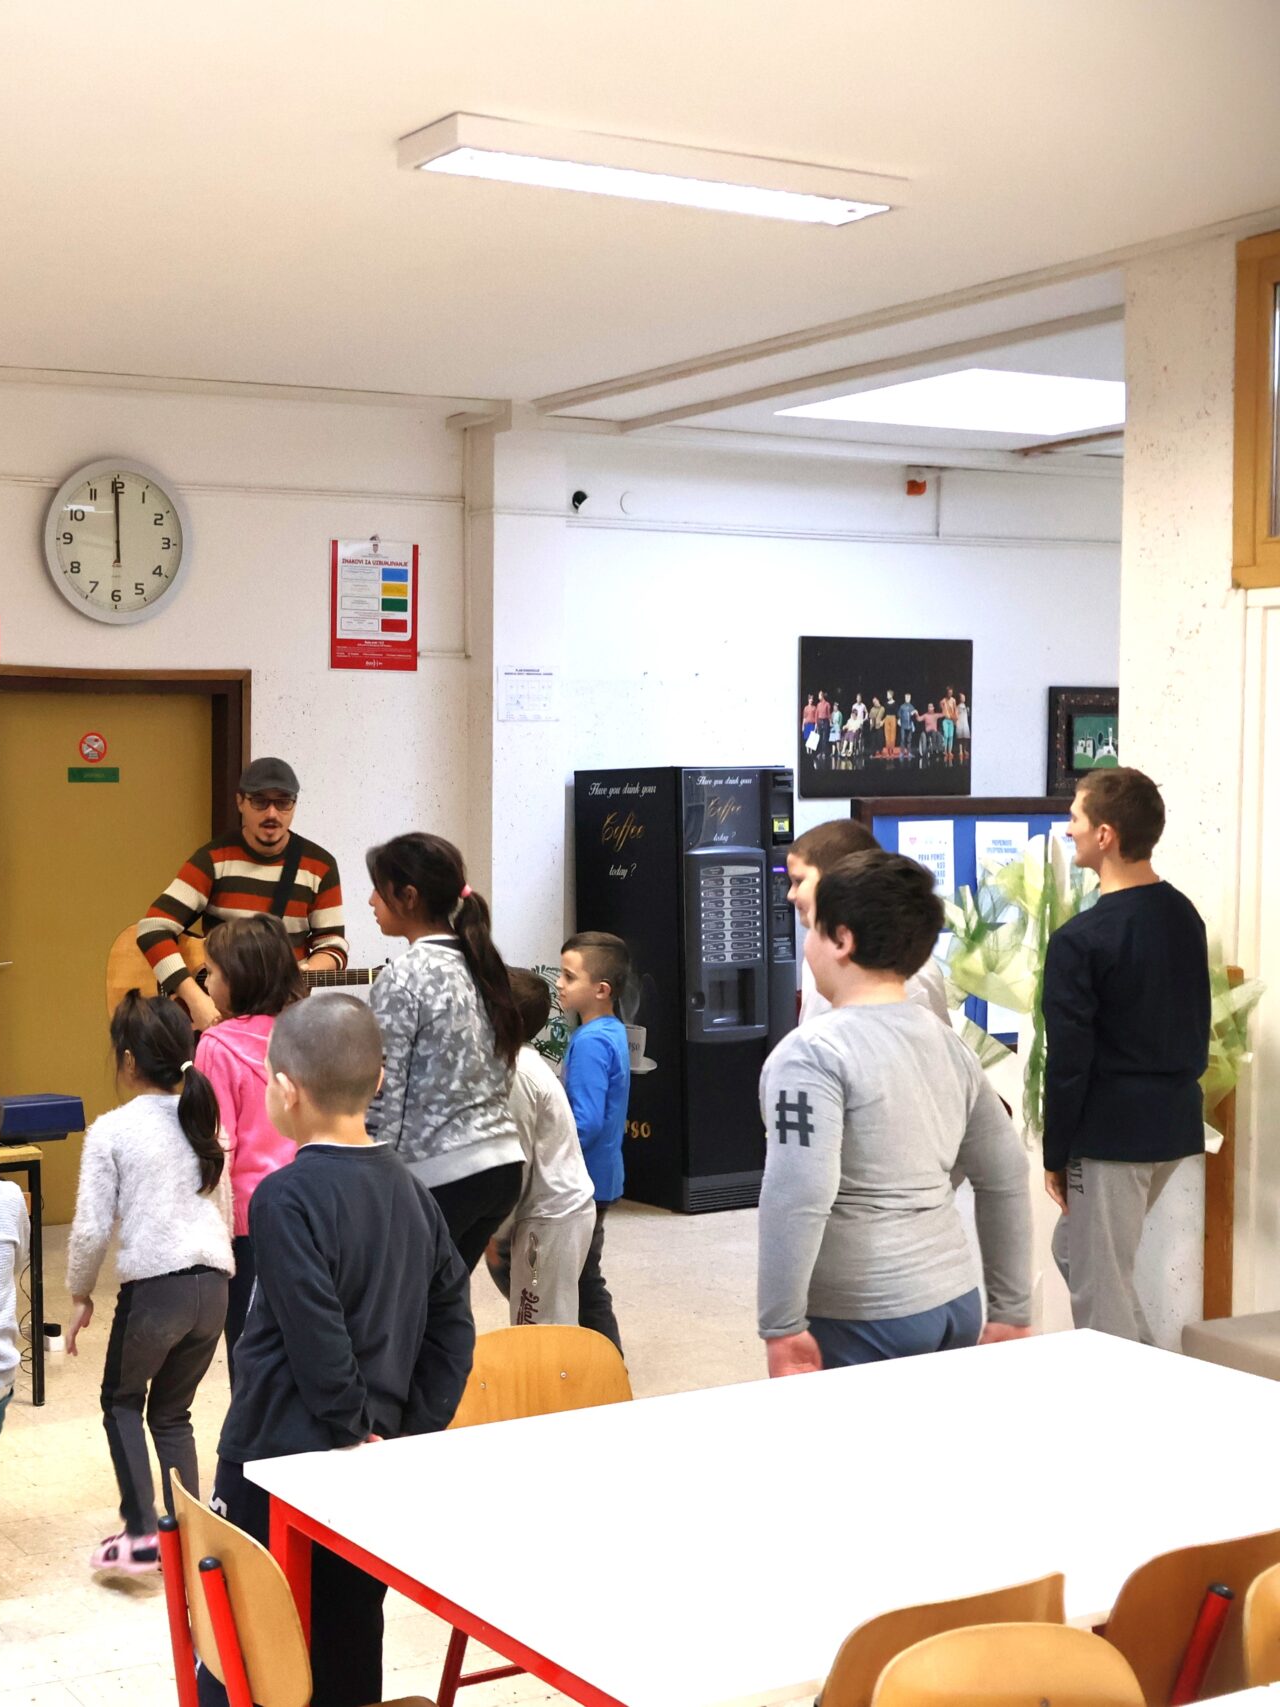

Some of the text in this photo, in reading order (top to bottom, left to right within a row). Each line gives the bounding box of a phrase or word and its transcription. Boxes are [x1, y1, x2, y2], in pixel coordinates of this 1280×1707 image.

[111, 481, 125, 494] 12
[89, 488, 97, 501] 11
[70, 509, 85, 521] 10
[154, 513, 164, 526] 2
[62, 532, 73, 545] 9
[161, 537, 171, 550] 3
[70, 561, 81, 574] 8
[152, 565, 163, 577] 4
[89, 581, 99, 593] 7
[134, 583, 145, 595] 5
[111, 589, 121, 602] 6
[712, 779, 724, 788] you
[724, 776, 740, 785] drink
[588, 781, 657, 799] Have you drink your
[708, 796, 742, 824] Coffee
[601, 811, 645, 852] Coffee
[609, 864, 628, 880] today
[775, 1090, 815, 1147] #
